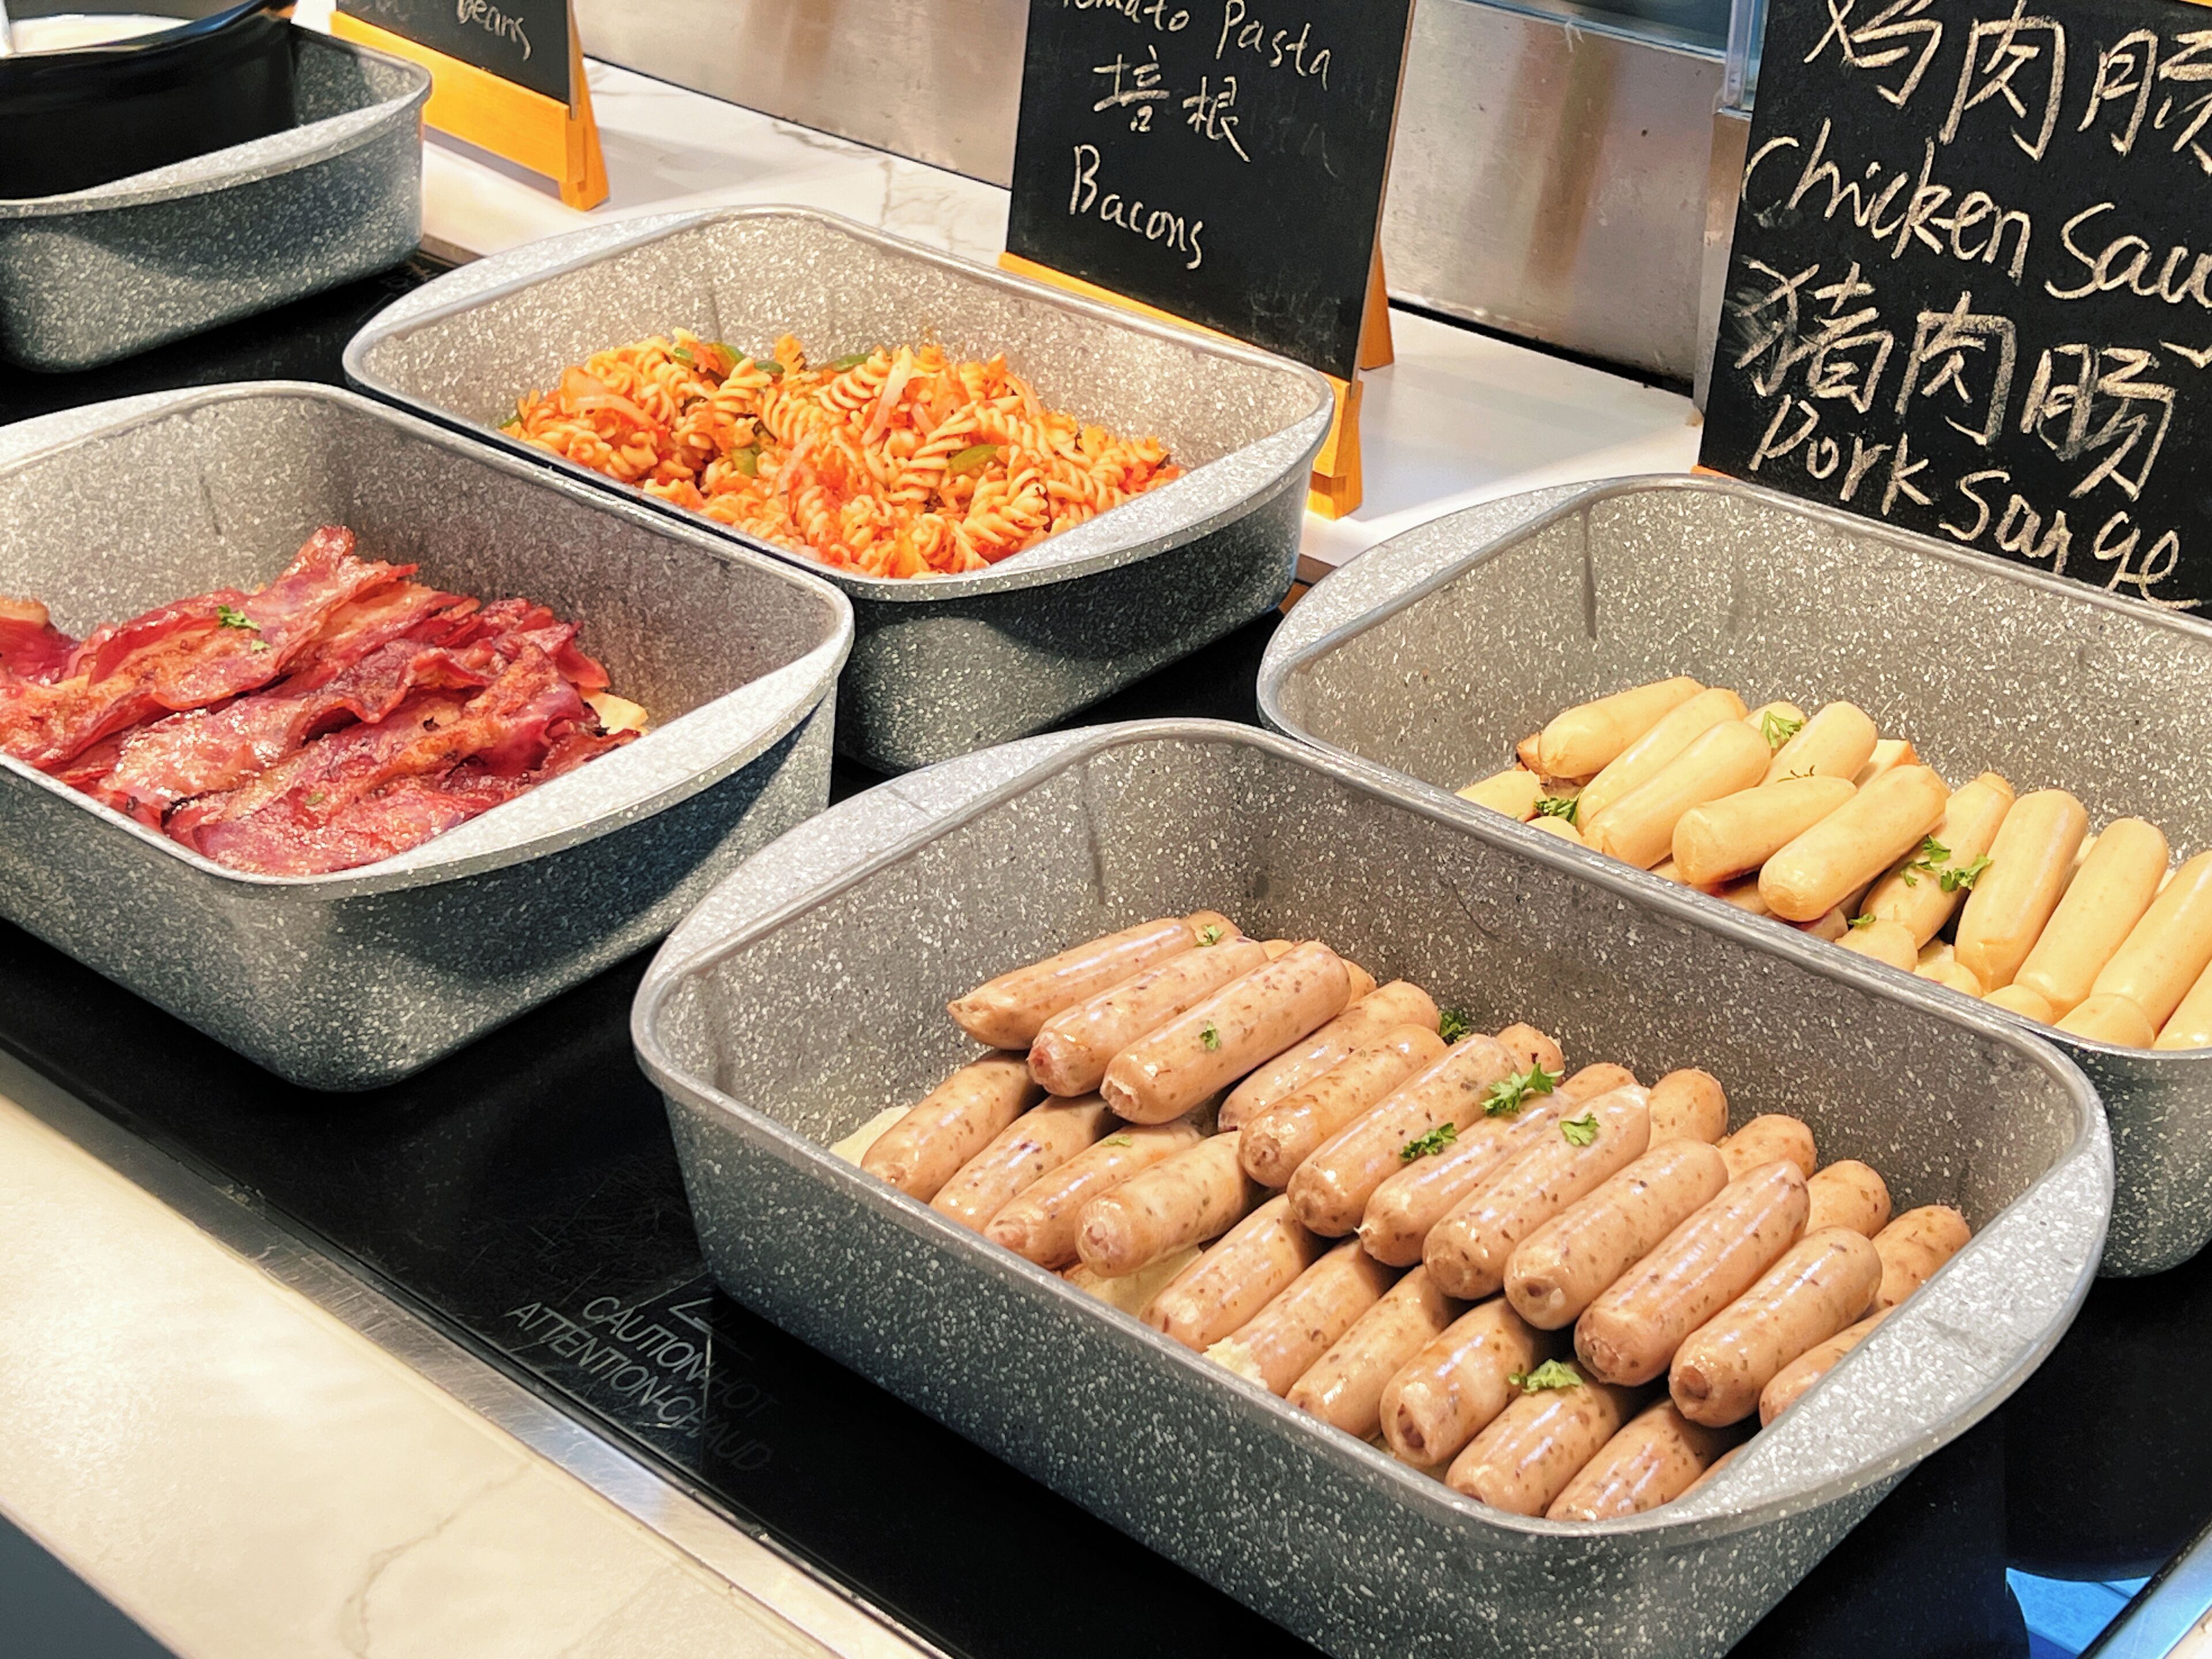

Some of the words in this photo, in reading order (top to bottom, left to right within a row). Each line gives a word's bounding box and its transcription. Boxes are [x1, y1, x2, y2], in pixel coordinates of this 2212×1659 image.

[1062, 0, 1190, 32] ato
[1215, 0, 1331, 90] Pasta
[1069, 143, 1204, 270] Bacons
[1741, 117, 2031, 285] Chicken
[2044, 202, 2212, 369] Sau
[1748, 393, 1934, 516] Pork
